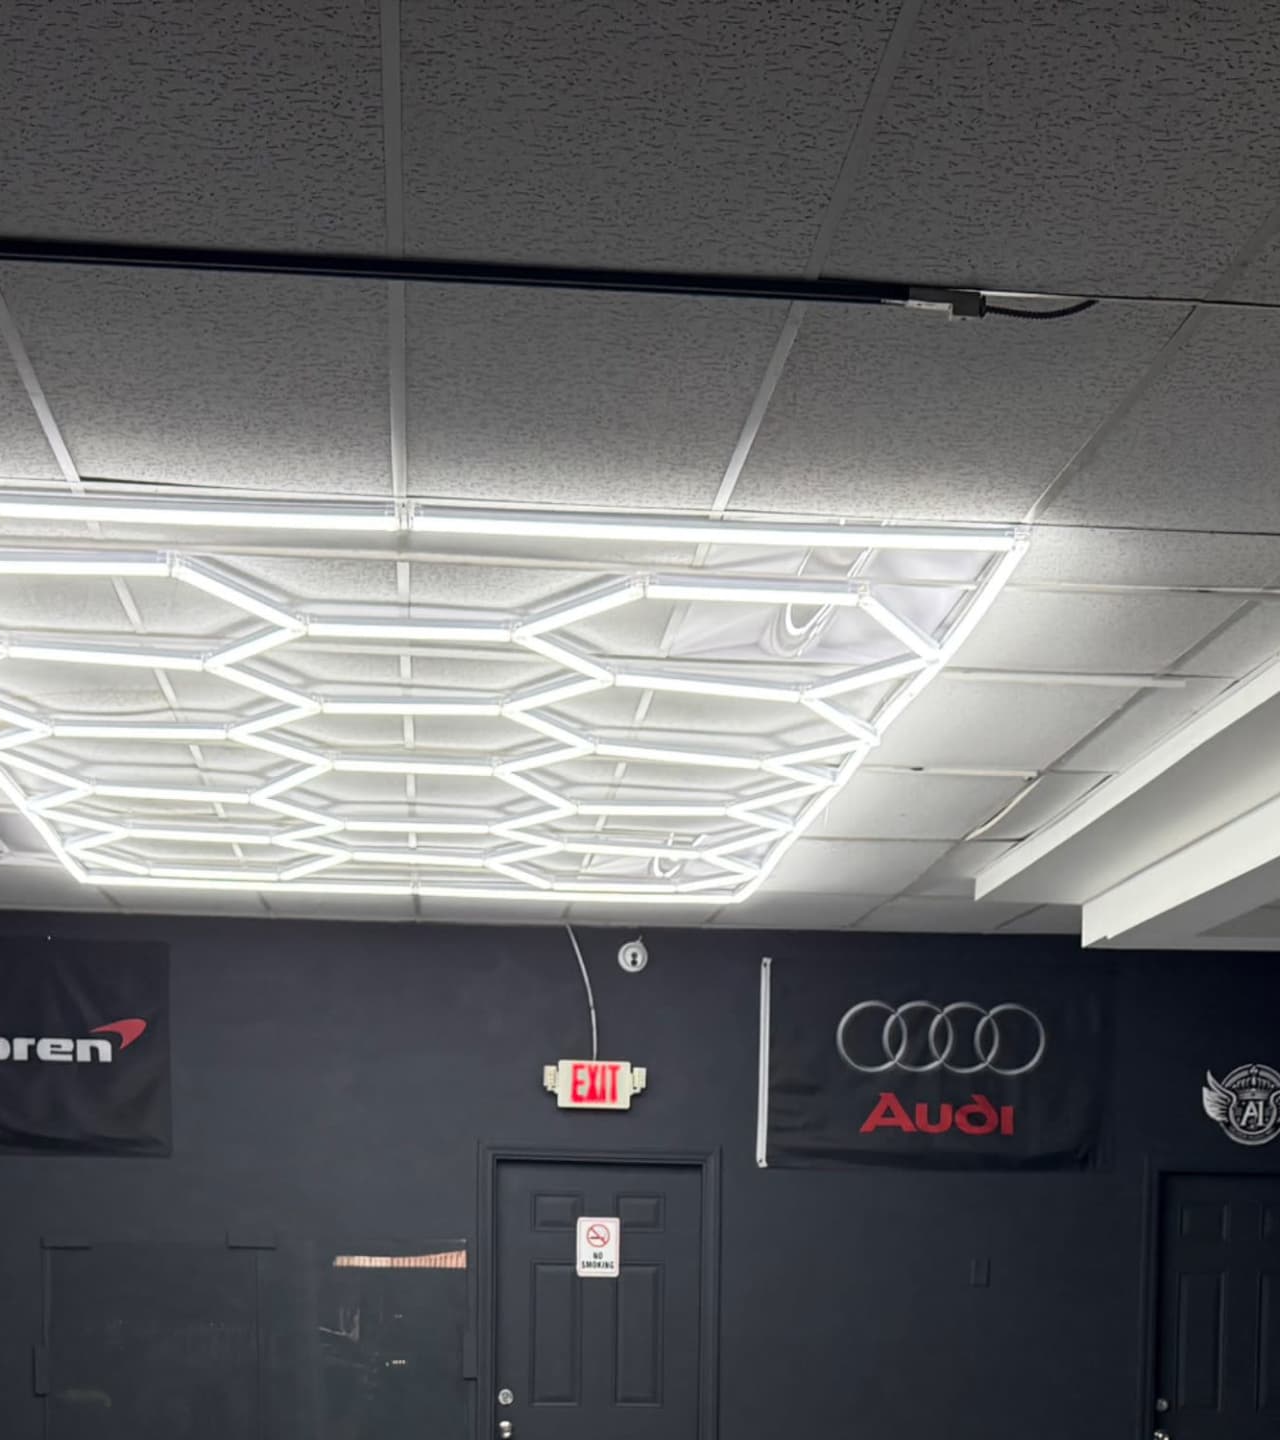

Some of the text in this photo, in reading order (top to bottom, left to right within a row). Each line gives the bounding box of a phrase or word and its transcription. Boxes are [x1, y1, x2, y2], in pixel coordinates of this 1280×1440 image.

[570, 1064, 620, 1104] EXIT
[859, 1092, 1015, 1136] Audi
[581, 1261, 615, 1270] SMOKING
[592, 1252, 604, 1260] NO
